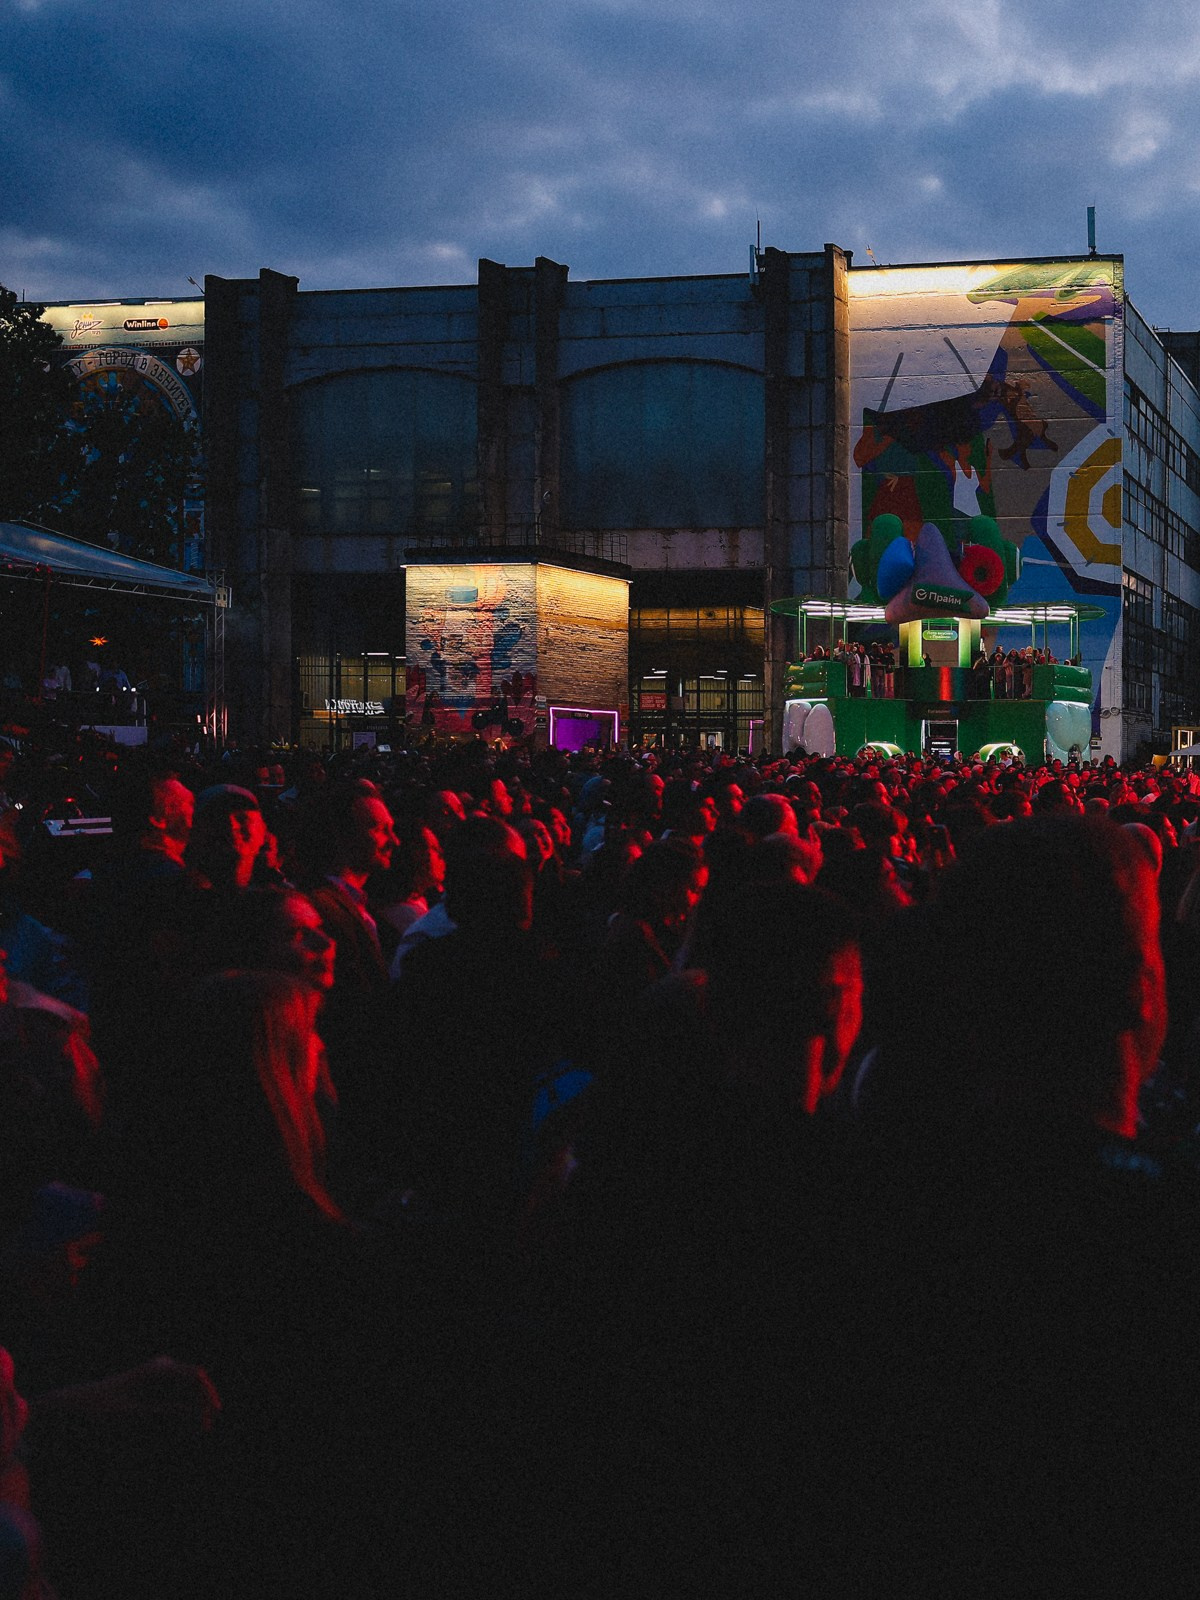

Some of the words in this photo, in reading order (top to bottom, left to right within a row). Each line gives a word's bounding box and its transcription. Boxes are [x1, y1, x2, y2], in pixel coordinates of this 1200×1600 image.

[126, 320, 157, 329] Winline
[98, 351, 136, 368] ГОРОД
[139, 357, 148, 371] В
[150, 363, 190, 411] ЗЕНИТЕ
[928, 591, 962, 605] Прайм
